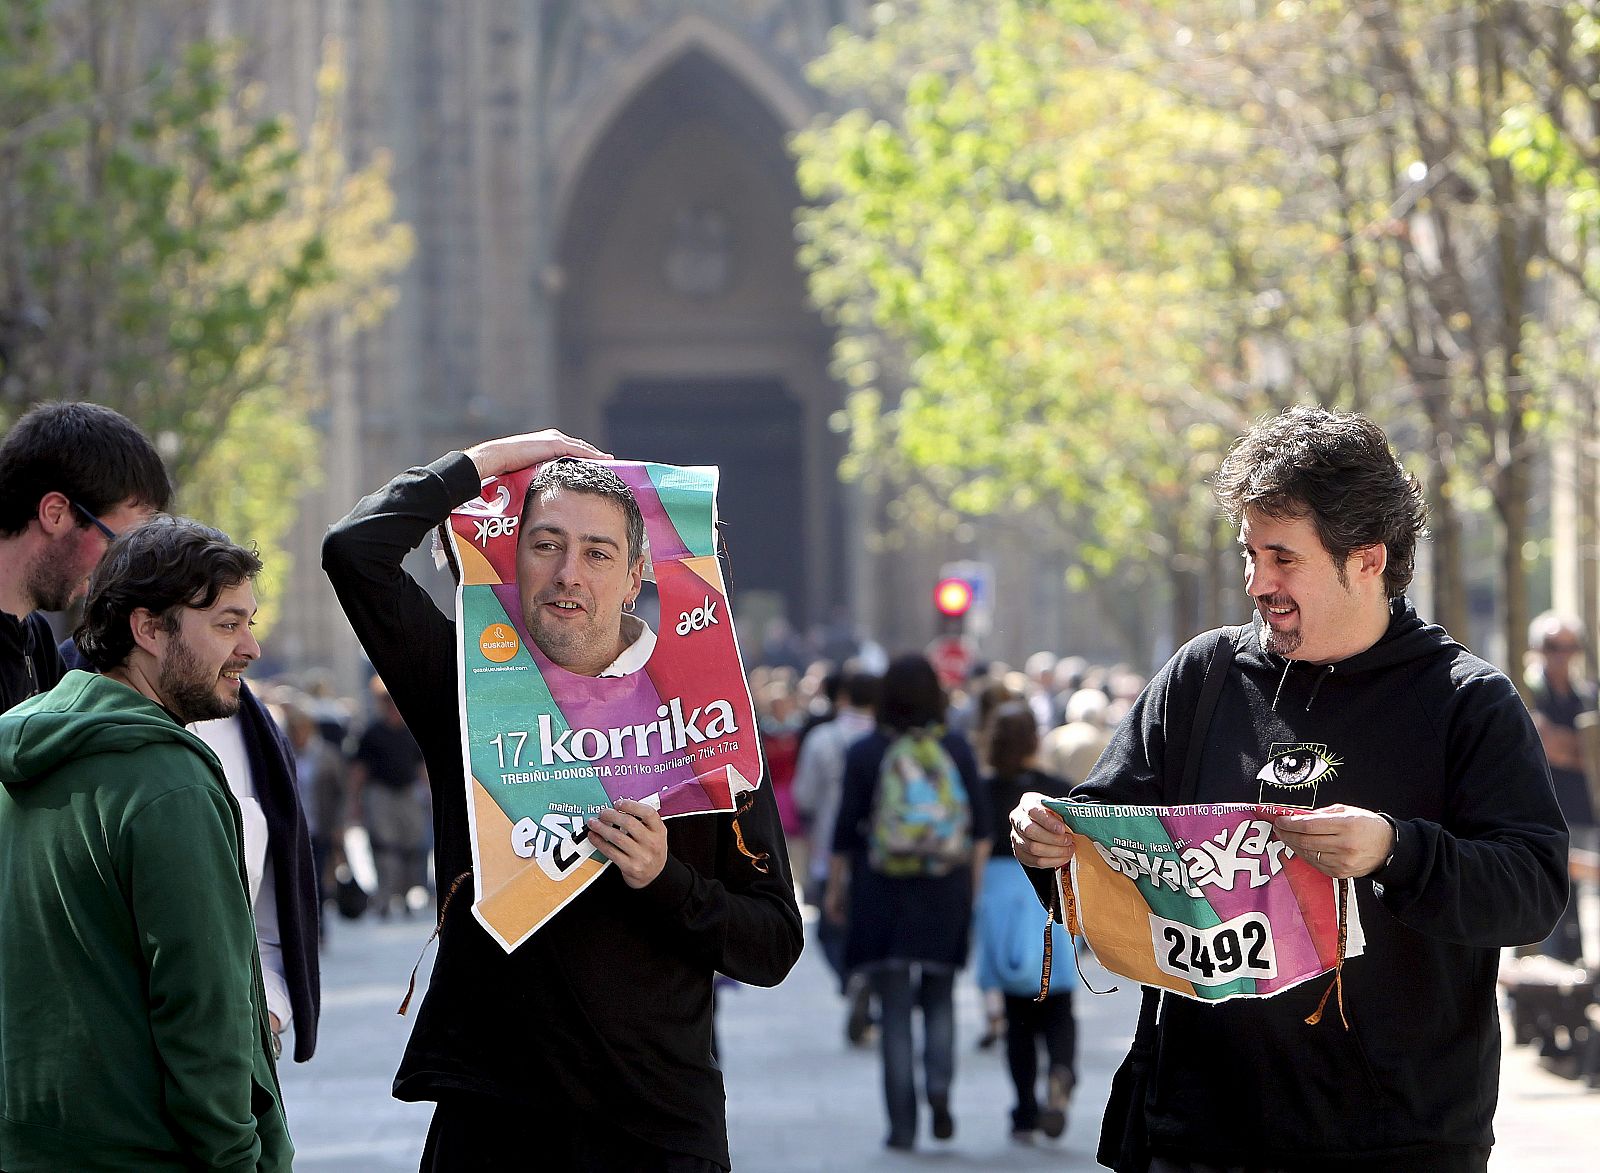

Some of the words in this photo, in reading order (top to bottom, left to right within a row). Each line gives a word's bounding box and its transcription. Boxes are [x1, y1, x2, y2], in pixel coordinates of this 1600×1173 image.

[472, 515, 519, 548] aek
[675, 595, 720, 637] aek
[482, 640, 516, 649] euskaltel
[489, 731, 535, 769] 17.
[537, 696, 739, 767] korrika
[500, 764, 613, 785] TREBIÑU-DONOSTIA
[614, 763, 652, 776] 2011ko
[654, 753, 697, 775] apirilaren
[697, 746, 716, 760] 7tik
[717, 740, 739, 754] 17ra
[548, 802, 585, 815] maitatu,
[1173, 804, 1209, 817] 2011ko
[1113, 837, 1148, 853] maitatu,
[1149, 841, 1175, 853] ikasi,
[1163, 920, 1271, 978] 2492
